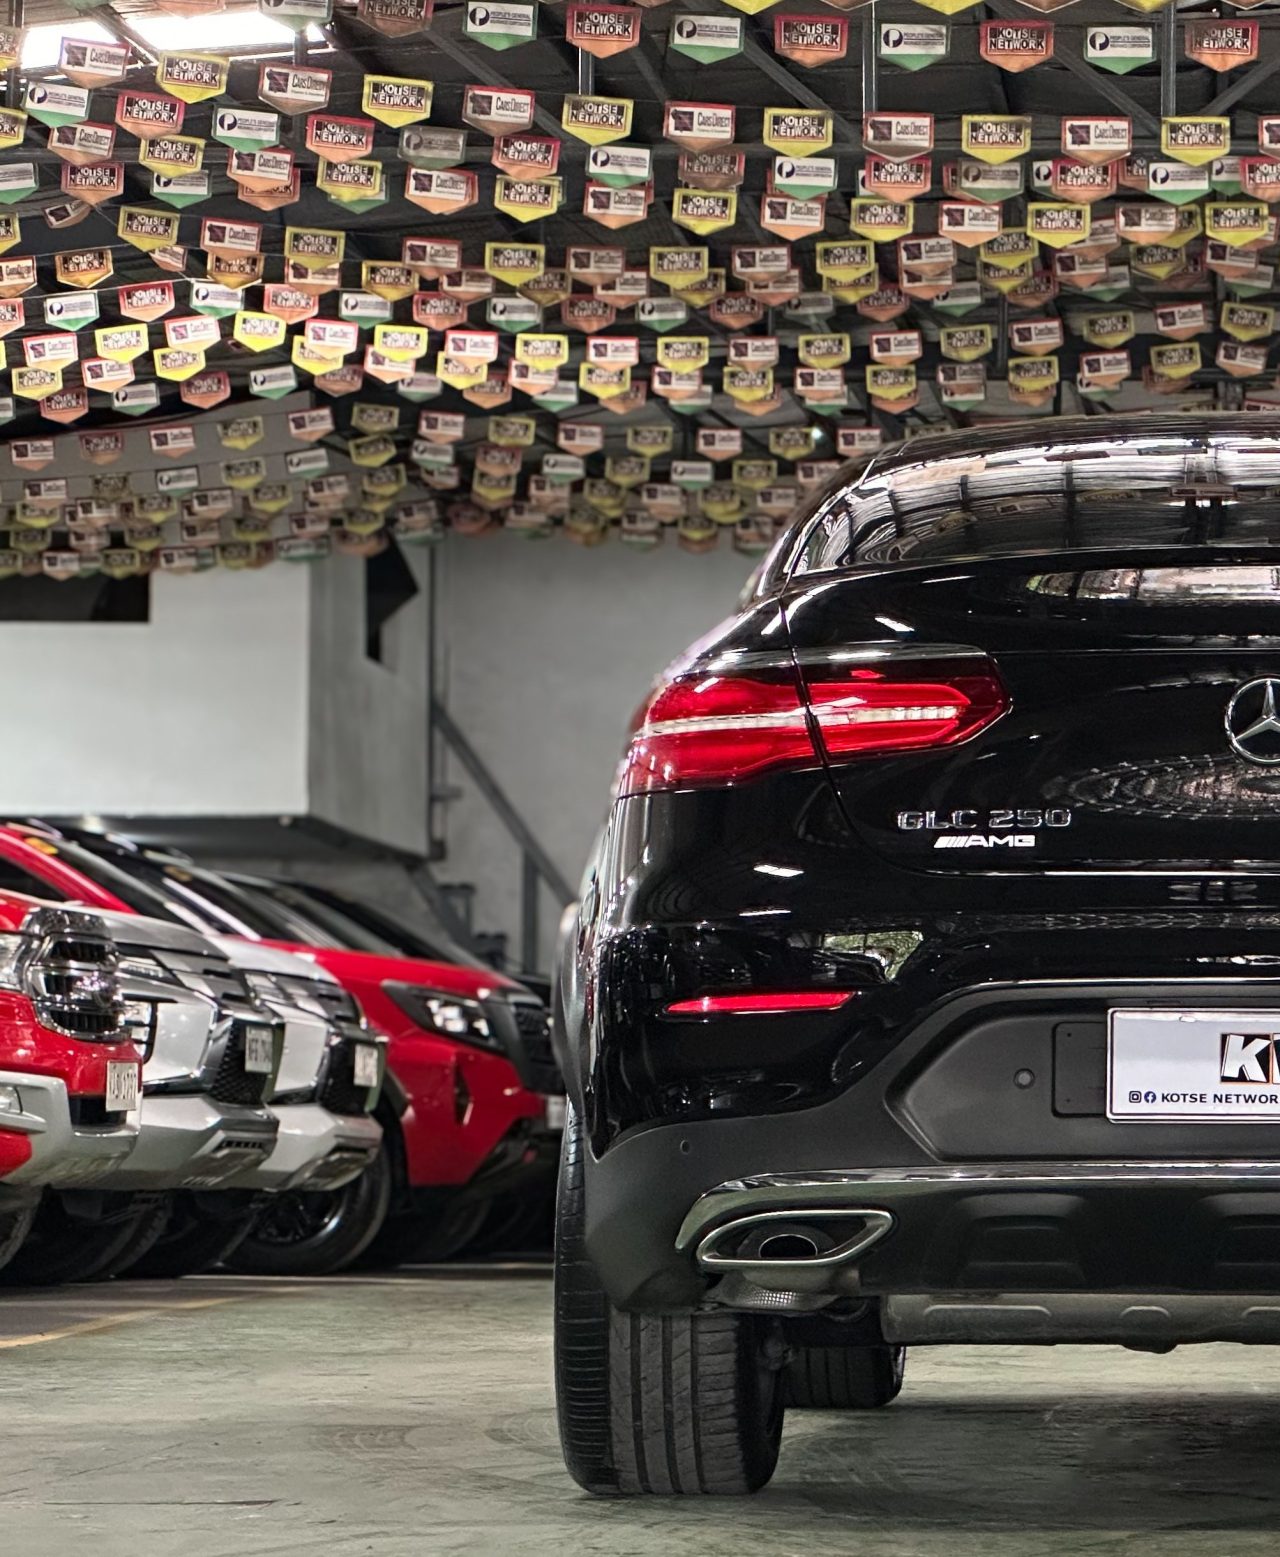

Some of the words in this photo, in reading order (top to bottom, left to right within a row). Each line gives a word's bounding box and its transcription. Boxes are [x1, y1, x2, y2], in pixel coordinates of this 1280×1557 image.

[586, 13, 623, 24] KOTSE
[576, 23, 630, 35] NETWORK
[792, 23, 831, 34] KOTSE
[998, 28, 1037, 38] KOTSE
[784, 34, 839, 46] NETWORK
[989, 38, 1043, 49] NETWORK
[381, 85, 416, 95] KOTSE
[134, 97, 170, 111] KOTSE
[372, 93, 423, 107] NETWORK
[581, 102, 616, 113] KOTSE
[125, 106, 176, 122] NETWORK
[571, 110, 623, 126] NETWORK
[897, 809, 978, 830] GLC
[988, 808, 1072, 828] 250
[965, 834, 1036, 848] AMG
[1161, 1093, 1208, 1104] KOTSE
